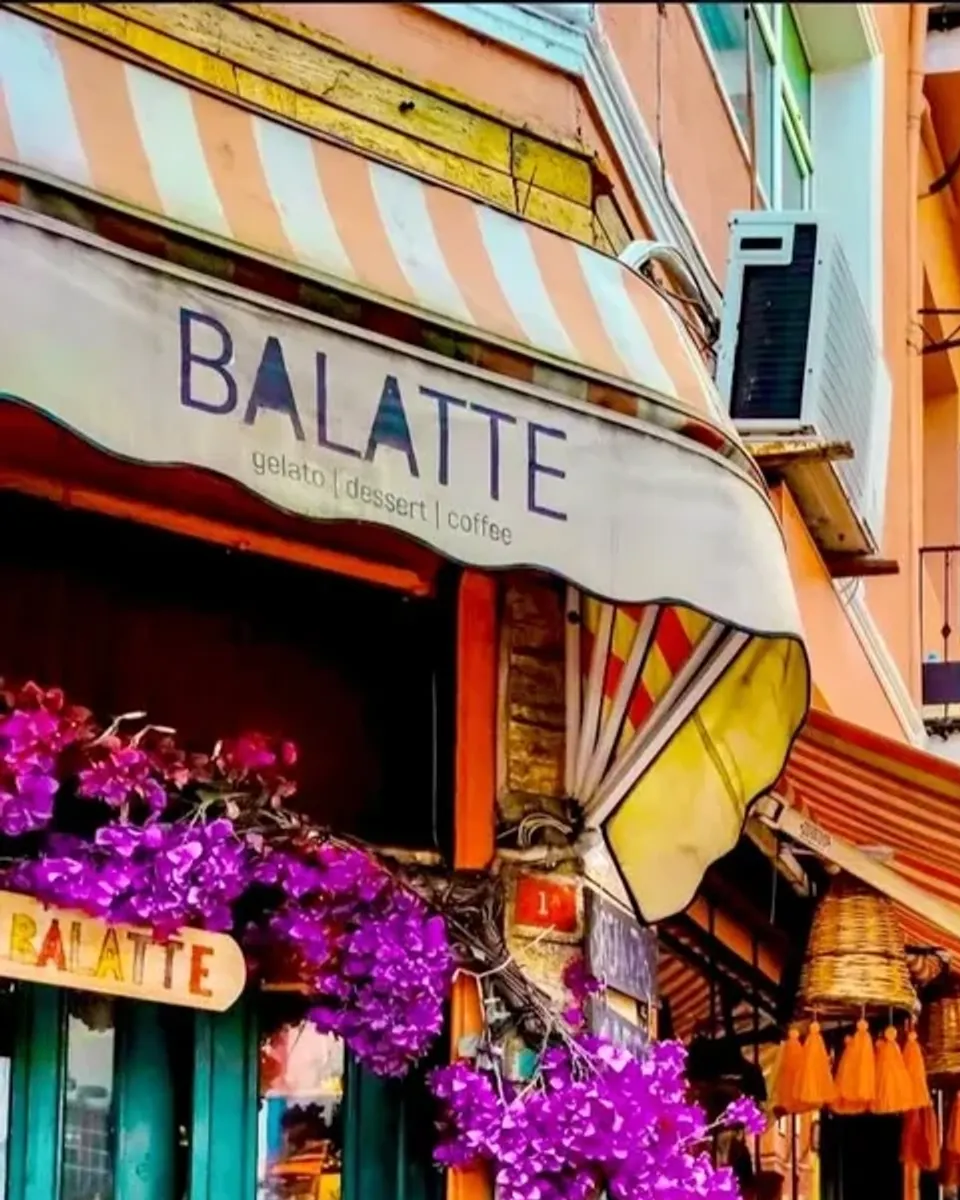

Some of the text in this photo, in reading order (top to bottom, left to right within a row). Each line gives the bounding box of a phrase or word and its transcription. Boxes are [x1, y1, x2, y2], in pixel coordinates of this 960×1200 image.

[179, 306, 568, 522] BALATTE
[251, 450, 326, 489] gelato
[345, 476, 427, 522] dessert
[447, 509, 513, 546] coffee
[10, 912, 215, 998] BALATTE
